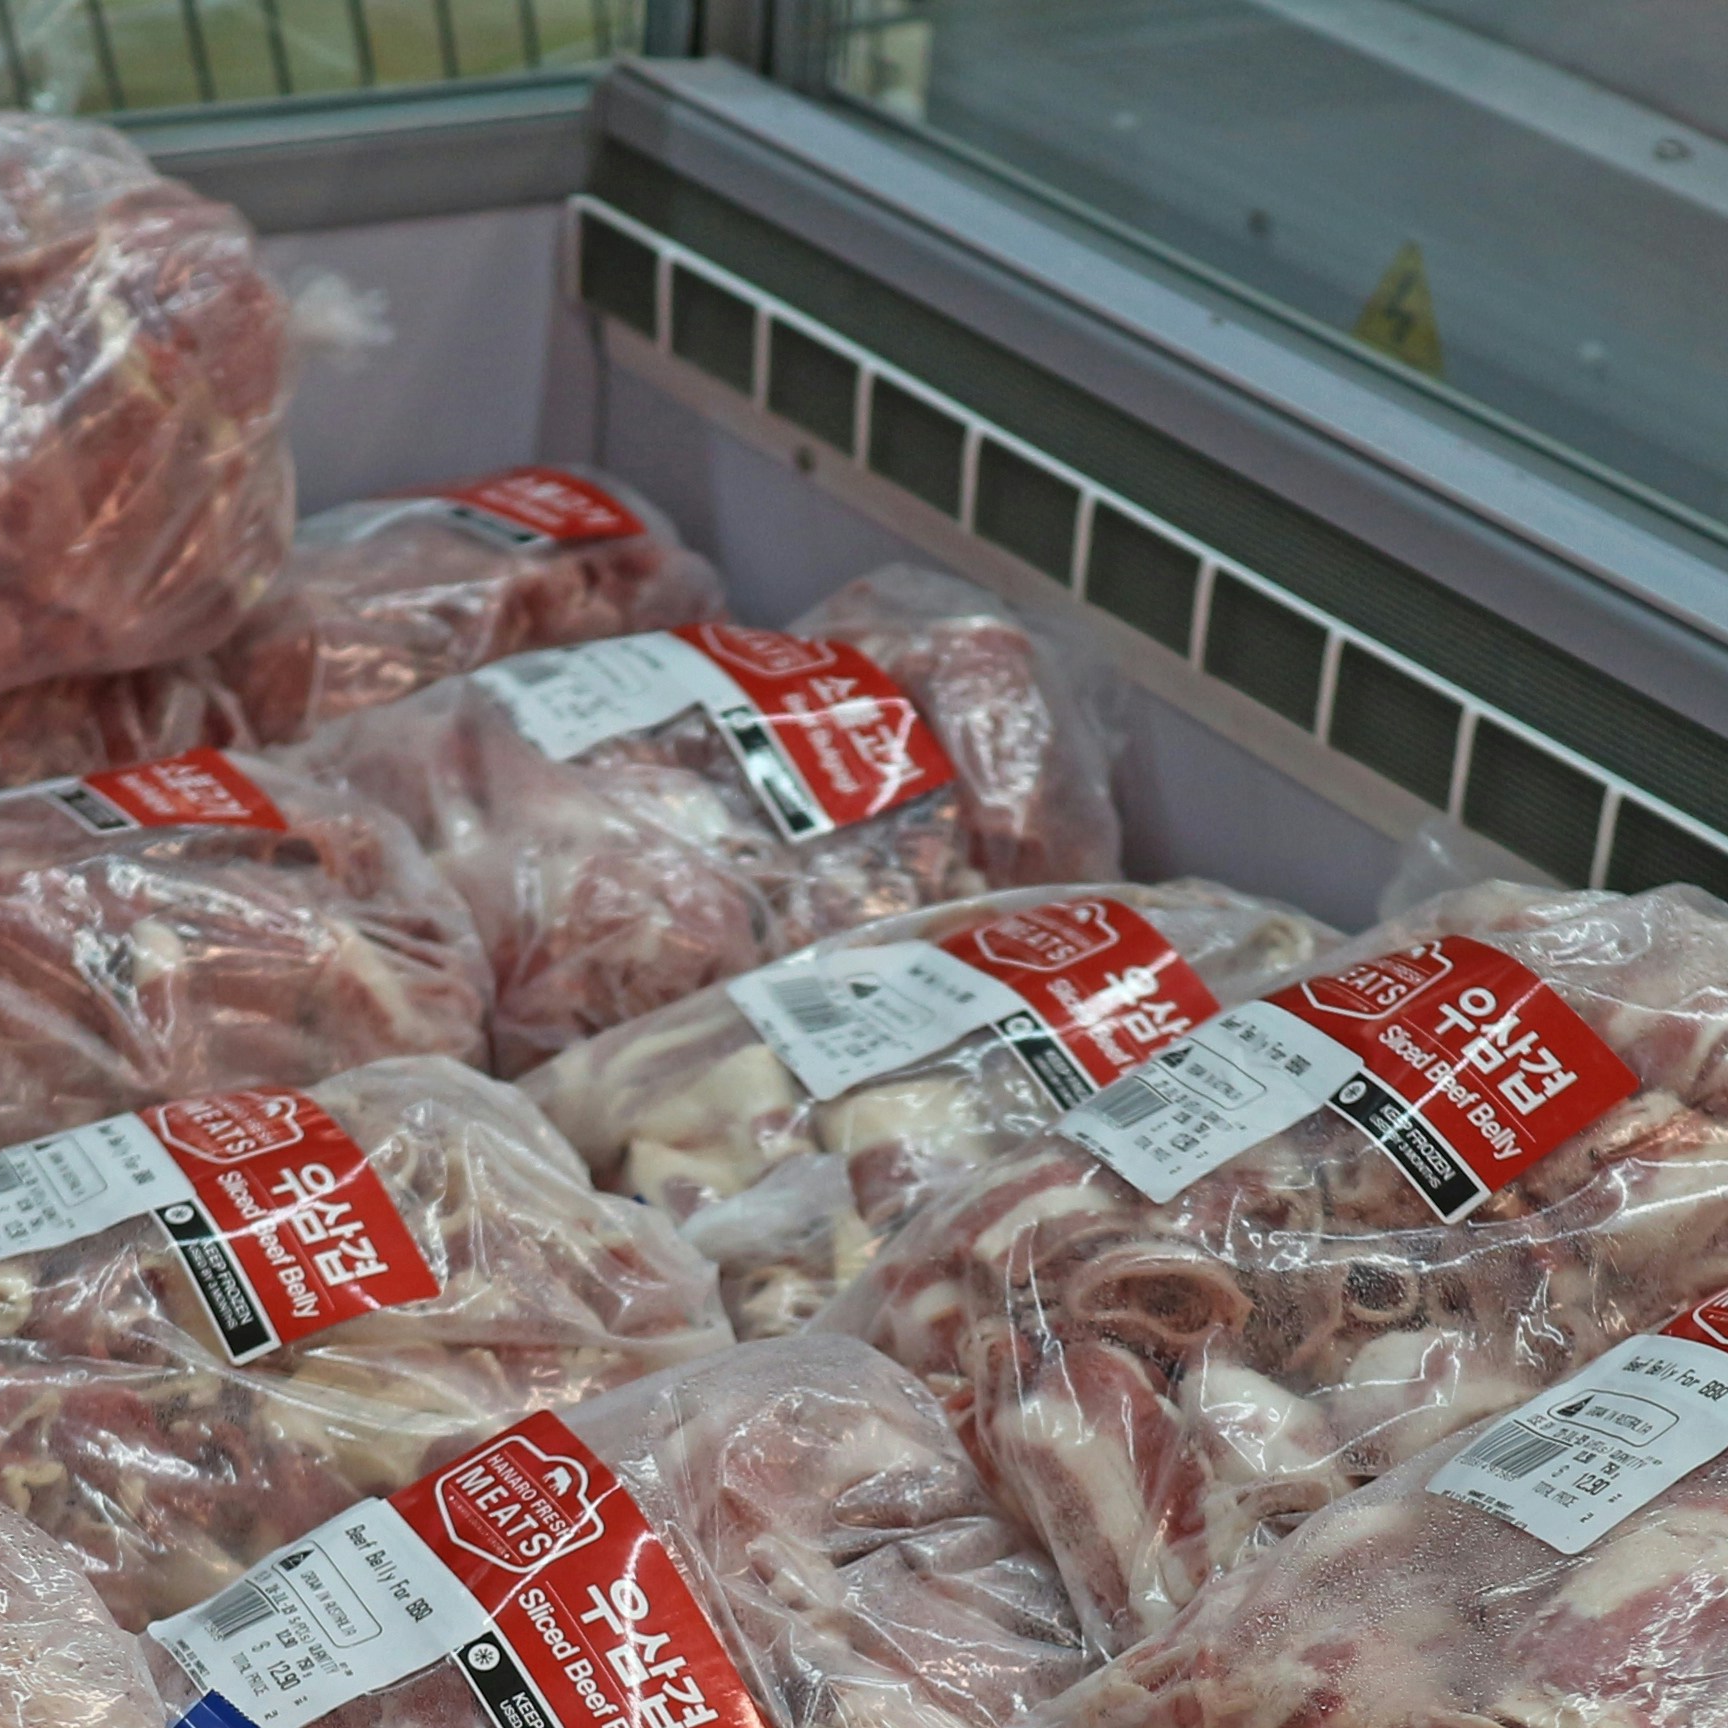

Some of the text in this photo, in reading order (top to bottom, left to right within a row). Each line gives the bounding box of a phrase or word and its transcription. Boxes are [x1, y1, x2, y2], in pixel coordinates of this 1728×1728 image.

[1434, 987, 1578, 1116] 우삼겹
[1406, 1128, 1456, 1181] FROZEN
[1467, 1103, 1522, 1161] Belly
[271, 1163, 389, 1286] 우삼겹
[220, 1270, 254, 1326] FROZEN
[279, 1266, 320, 1318] Belly
[1676, 1368, 1701, 1389] For
[486, 1453, 538, 1502] HANARO
[1571, 1471, 1612, 1497] 12.90
[455, 1464, 553, 1558] MEATS
[344, 1523, 434, 1624] Beef Belly For BBQ
[267, 1659, 302, 1691] 12.90
[518, 1587, 581, 1661] Sliced
[563, 1656, 620, 1718] Beef
